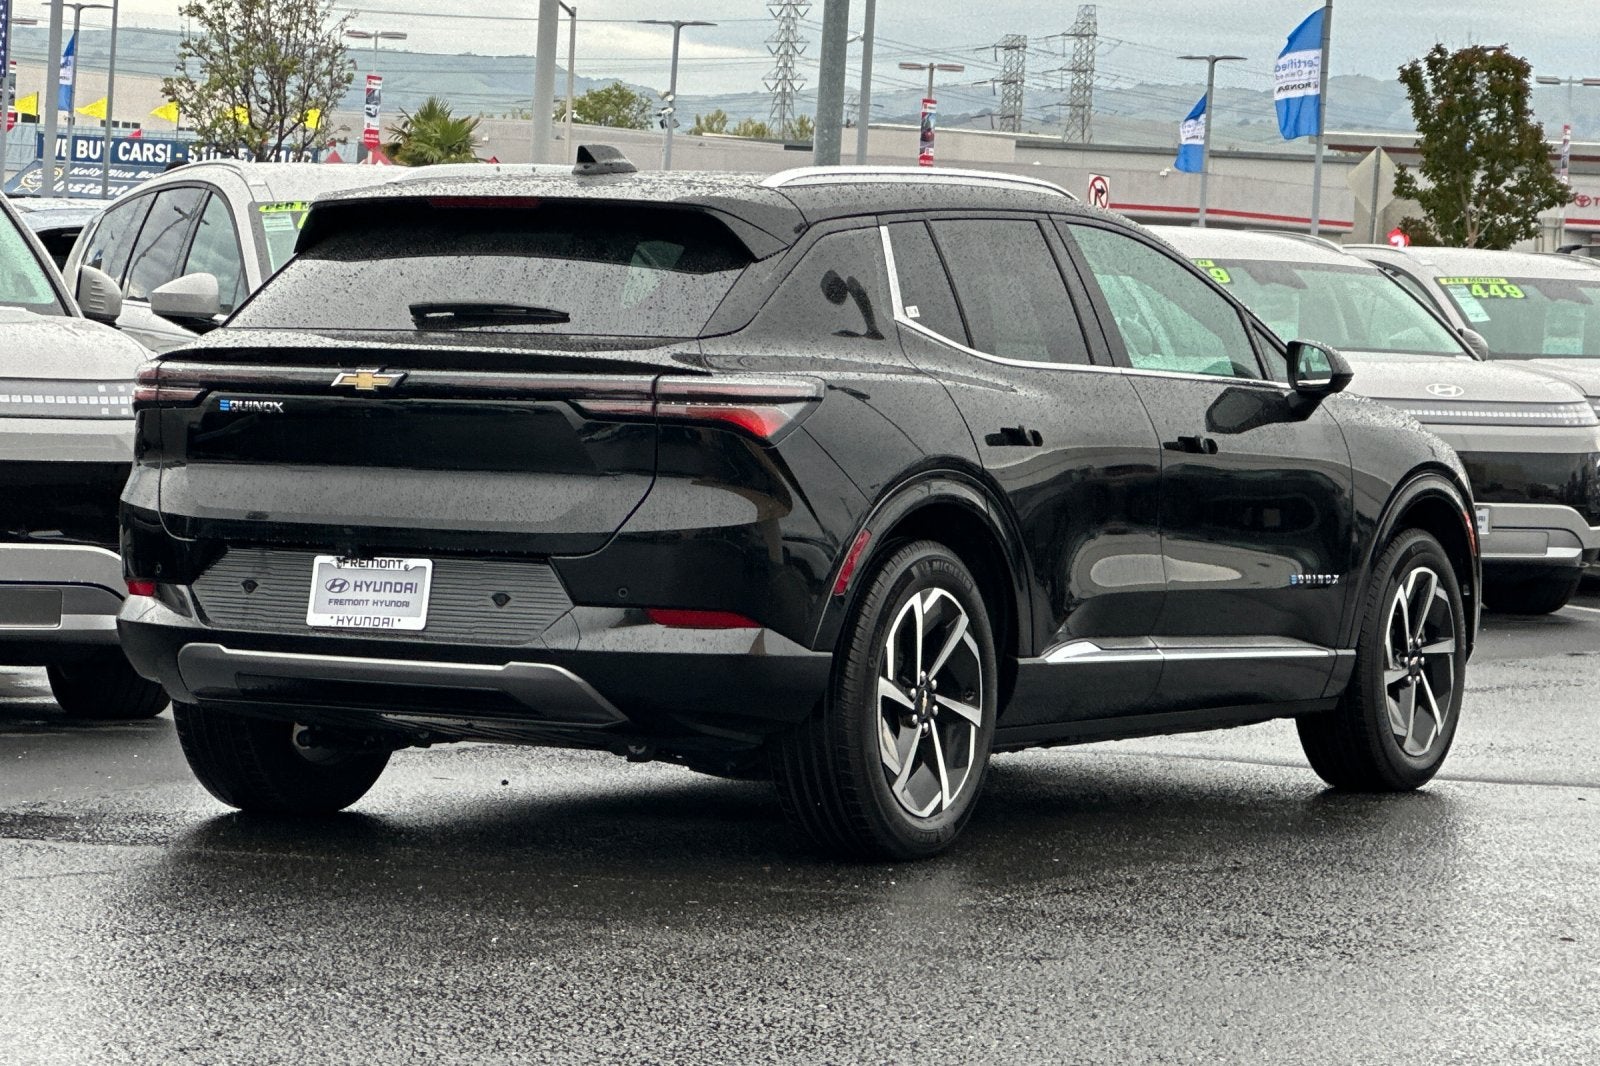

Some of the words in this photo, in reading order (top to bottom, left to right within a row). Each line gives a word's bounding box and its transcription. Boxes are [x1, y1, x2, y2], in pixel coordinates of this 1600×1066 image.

[76, 139, 114, 160] BUY
[118, 141, 171, 162] CARS!
[1471, 284, 1525, 298] 449
[219, 399, 284, 413] EQUINOX
[342, 558, 403, 569] FREMONT
[353, 580, 418, 594] HYUNDAI
[328, 598, 370, 607] FREMONT
[372, 600, 410, 608] HYUNDAI
[336, 616, 395, 627] HYUNDAI
